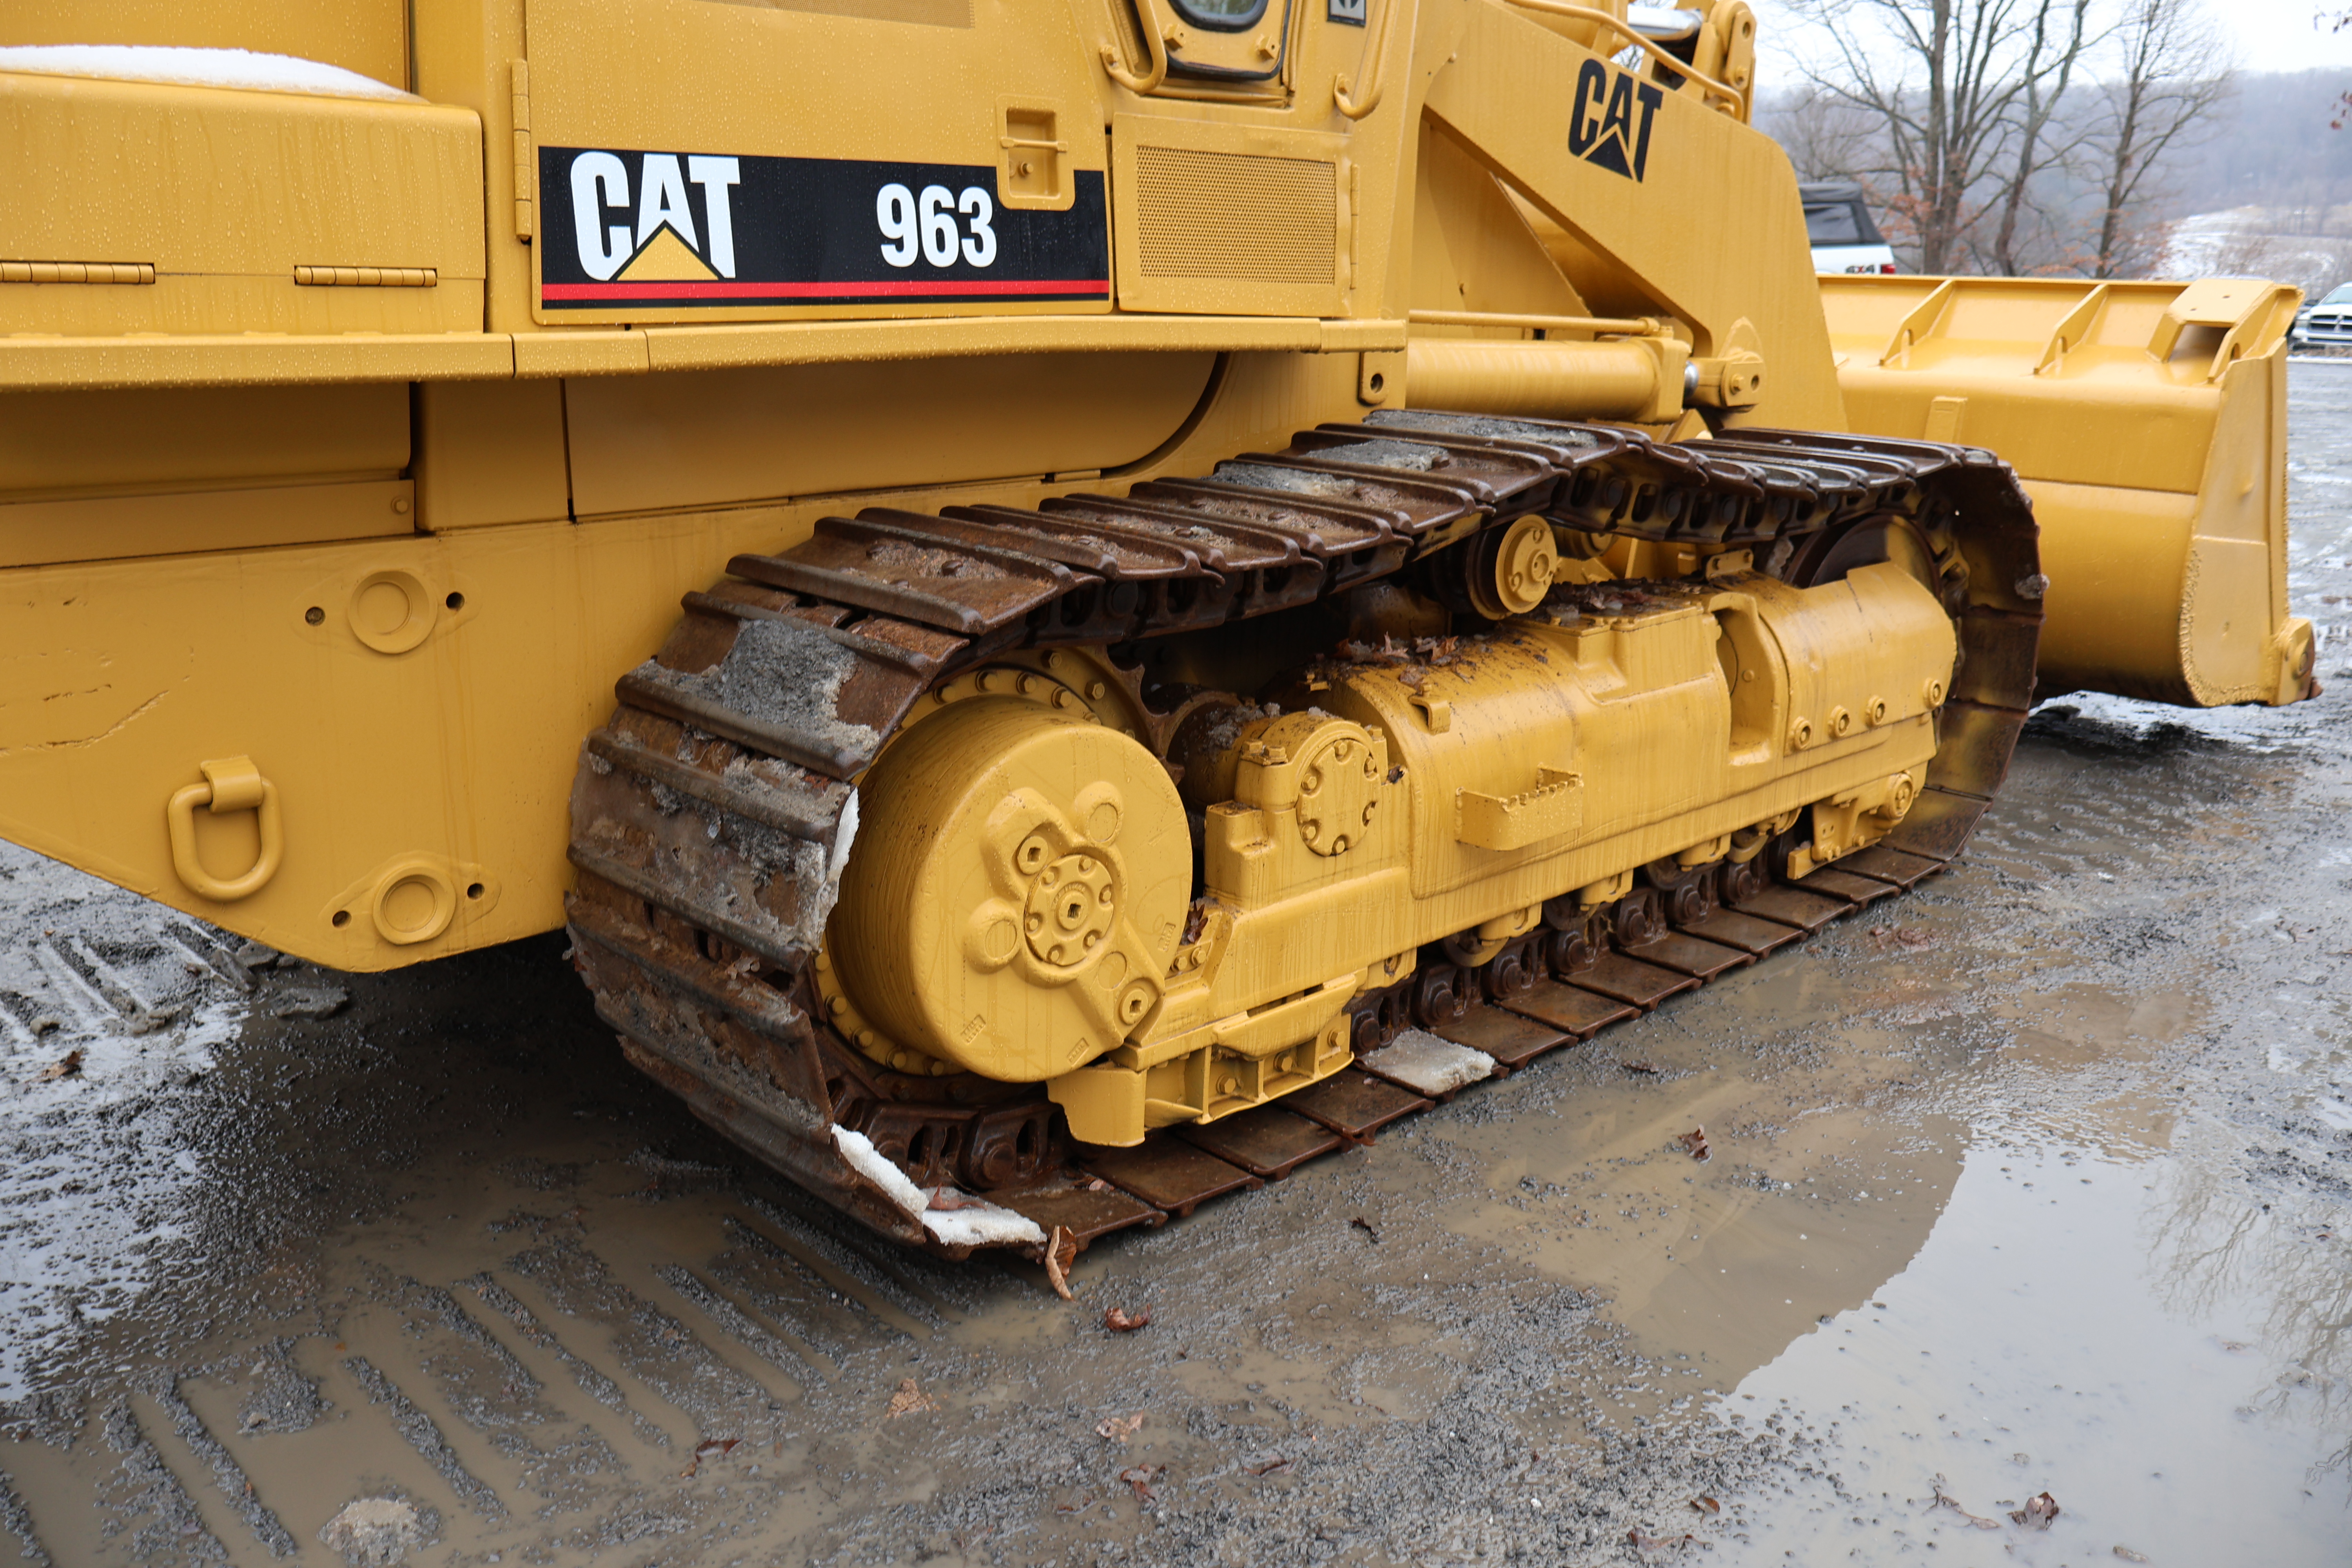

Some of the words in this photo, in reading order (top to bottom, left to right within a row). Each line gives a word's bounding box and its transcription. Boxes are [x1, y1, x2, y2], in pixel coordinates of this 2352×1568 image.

[1568, 58, 1663, 183] CAT
[571, 151, 741, 281] CAT
[877, 183, 997, 267] 963
